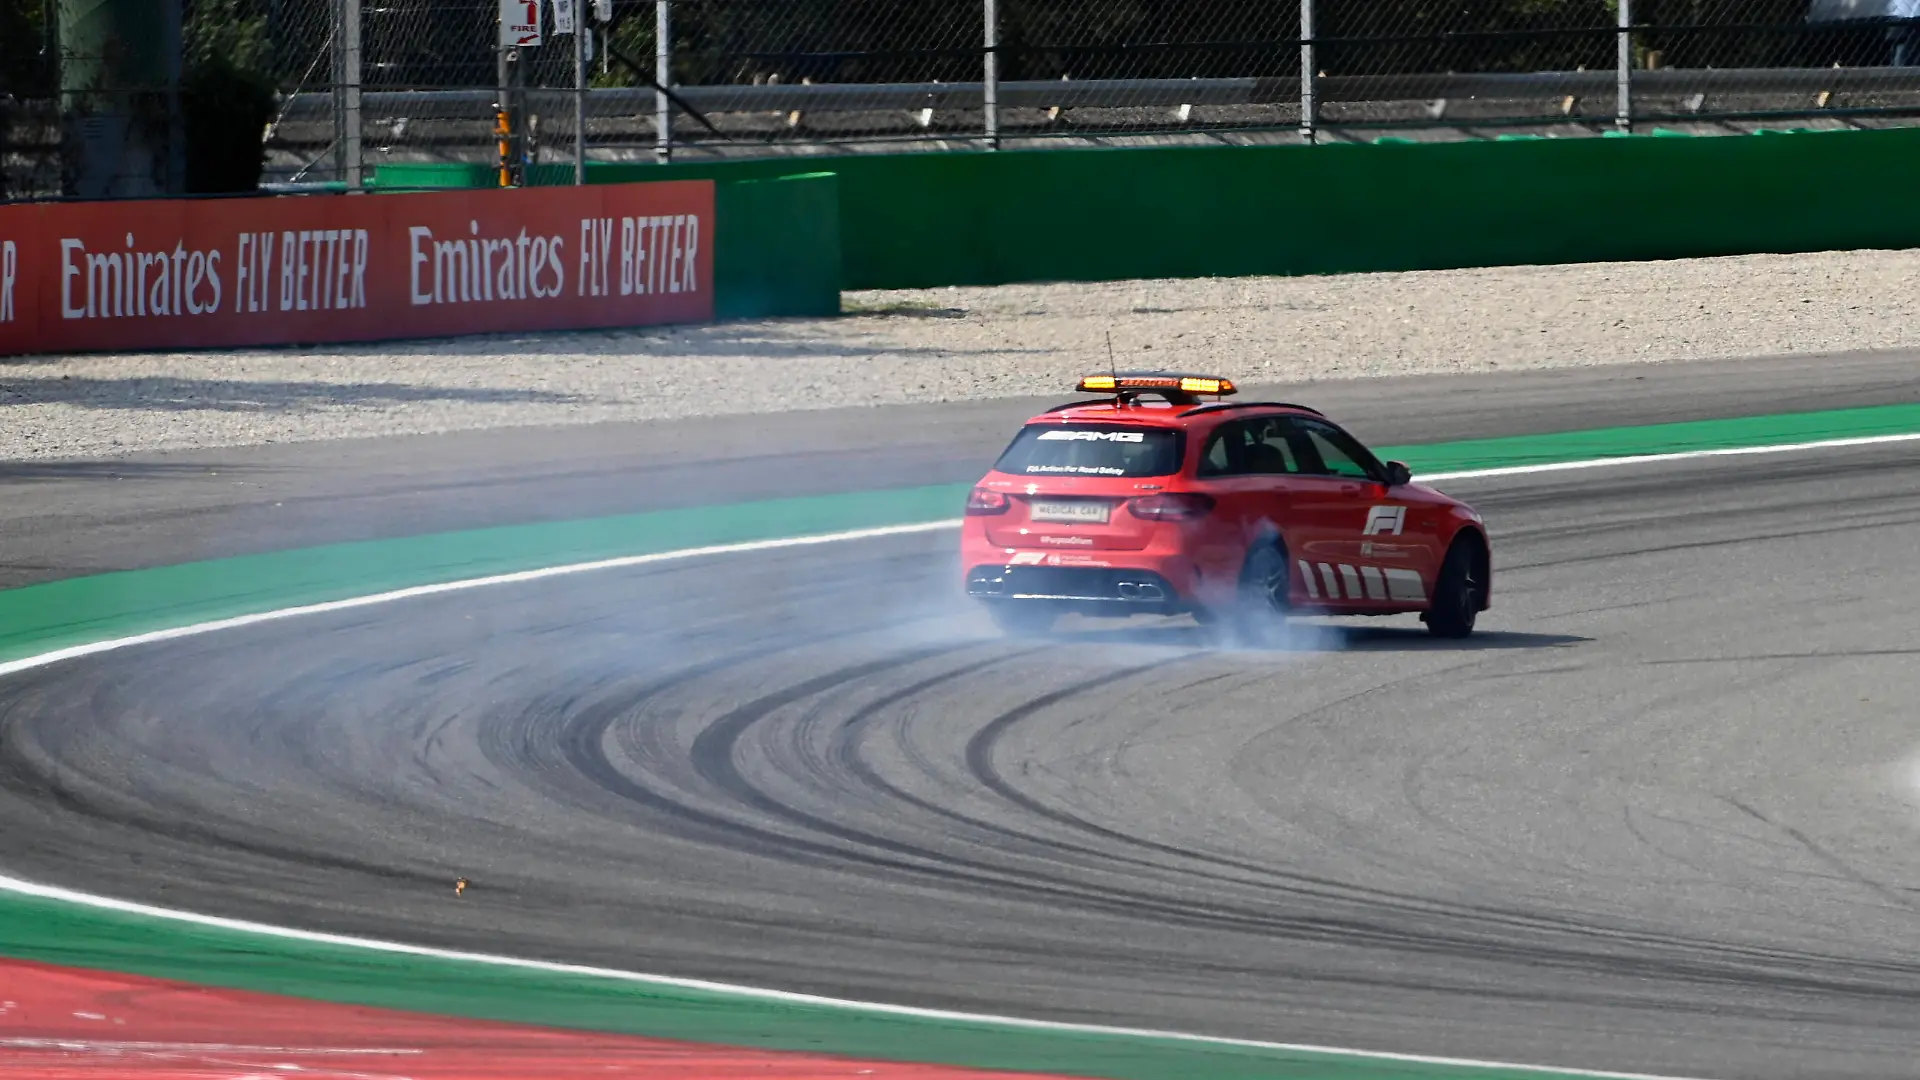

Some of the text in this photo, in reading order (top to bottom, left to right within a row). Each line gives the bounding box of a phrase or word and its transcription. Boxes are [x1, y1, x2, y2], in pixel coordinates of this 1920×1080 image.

[408, 214, 699, 306] Emirates FLY BETTER
[60, 228, 369, 319] Emirates FLY BETTER
[1066, 430, 1144, 443] AMG
[1041, 465, 1064, 473] Action
[1078, 466, 1099, 474] Road
[1099, 466, 1124, 476] Safety
[1039, 505, 1097, 515] MEDICAL CAR
